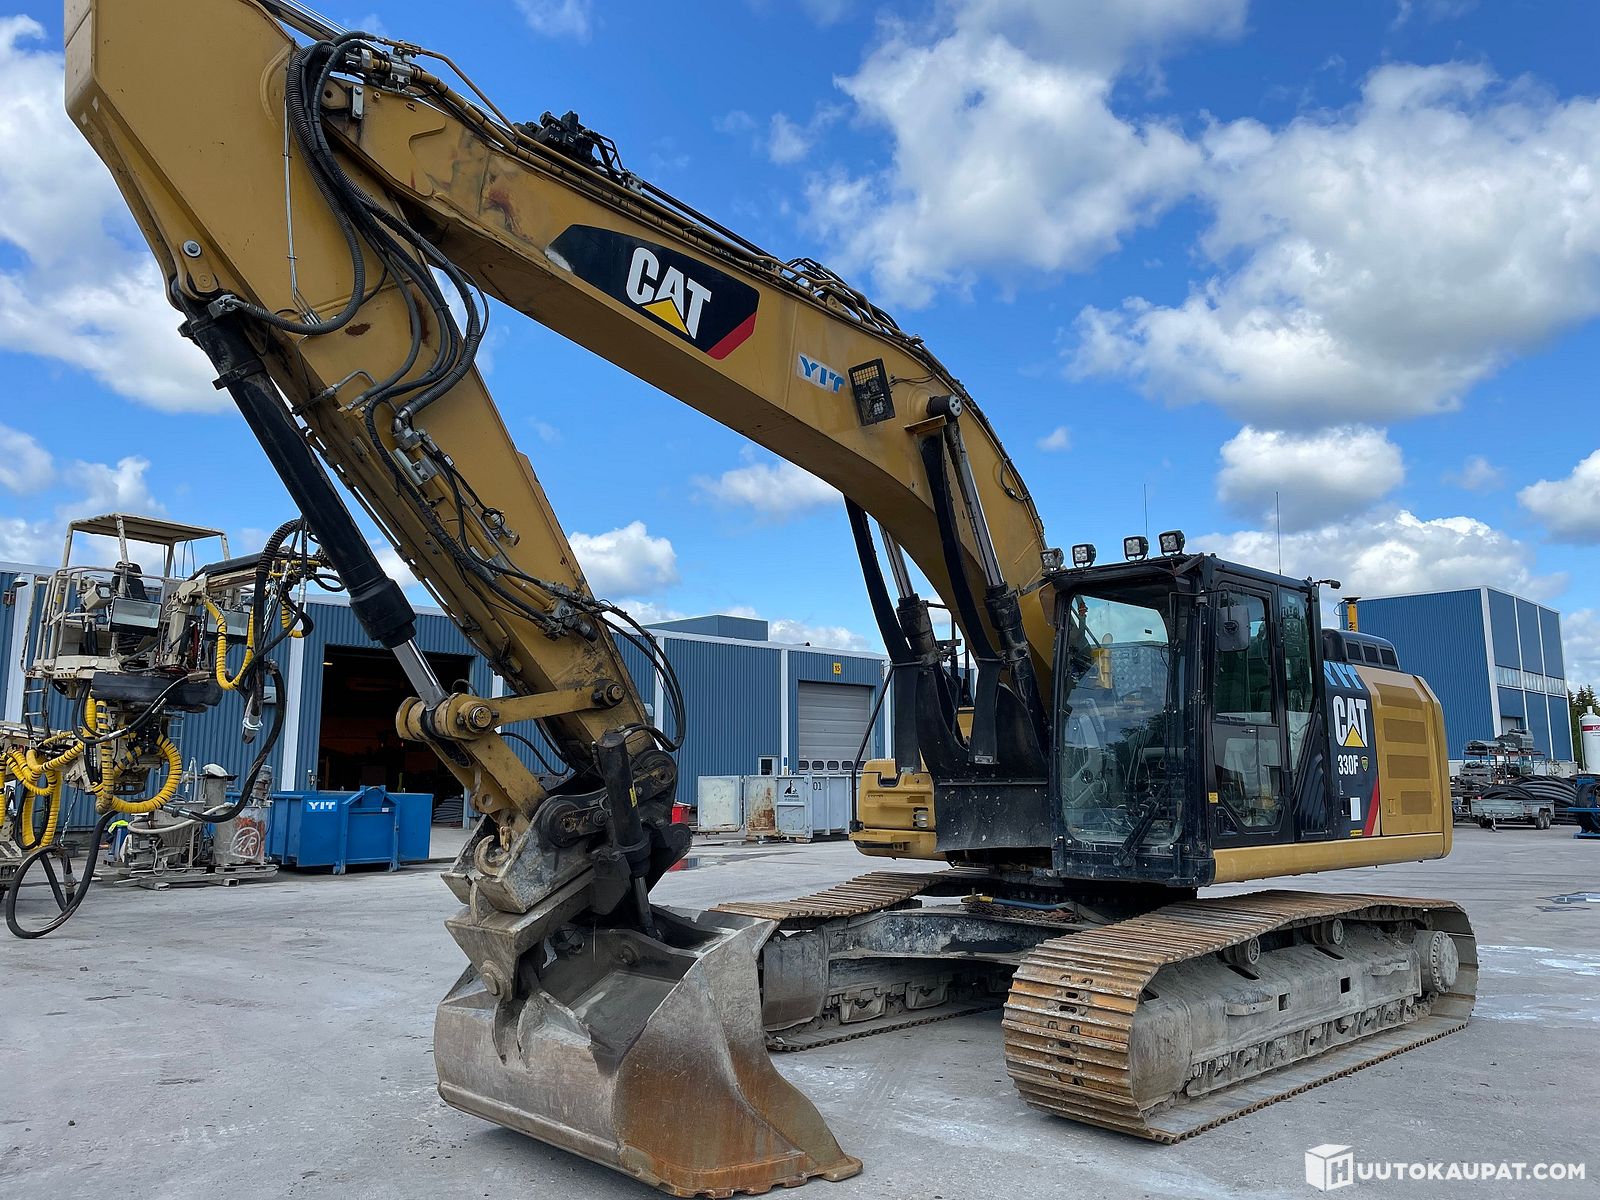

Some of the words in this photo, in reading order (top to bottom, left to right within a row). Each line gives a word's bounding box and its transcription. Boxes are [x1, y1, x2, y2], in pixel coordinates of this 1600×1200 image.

[626, 247, 712, 340] CAT
[800, 355, 845, 392] YIT
[1332, 695, 1368, 748] CAT
[1337, 754, 1359, 775] 330F
[812, 781, 823, 791] 01
[308, 801, 336, 810] YIT
